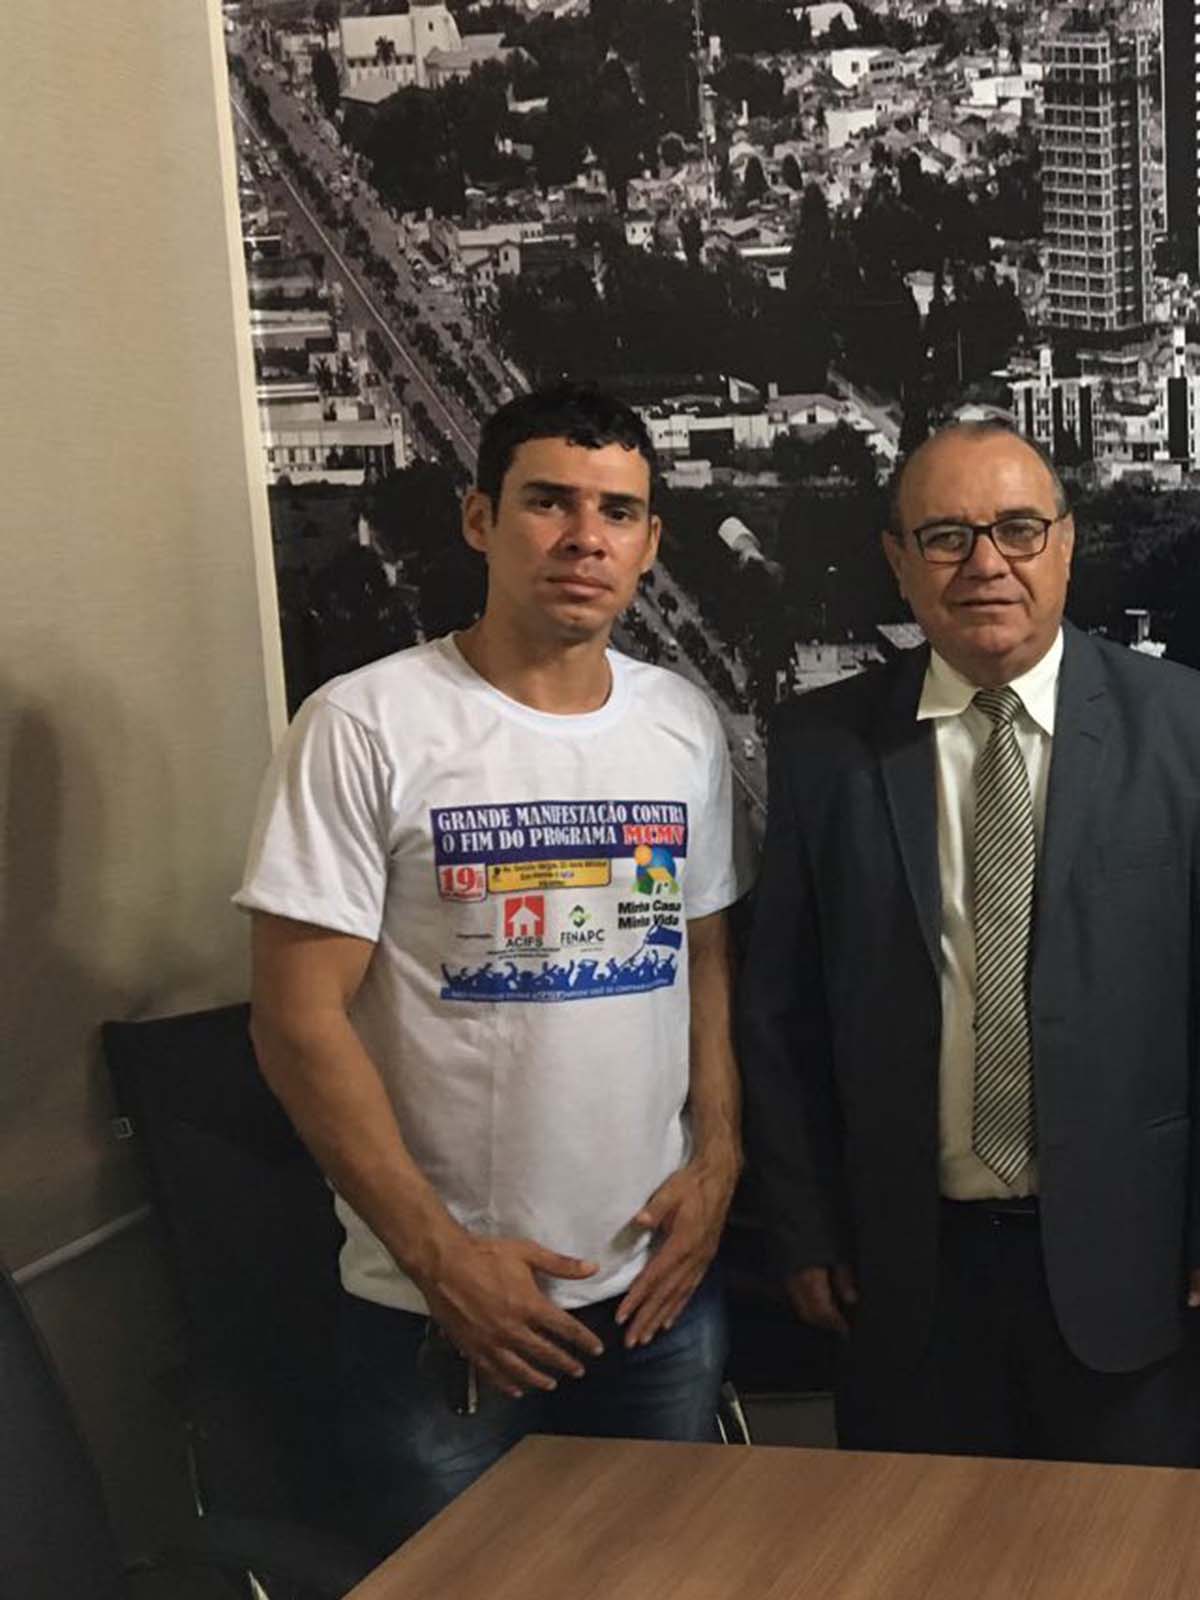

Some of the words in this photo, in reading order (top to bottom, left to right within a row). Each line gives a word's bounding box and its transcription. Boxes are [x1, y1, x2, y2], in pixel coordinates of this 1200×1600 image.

[437, 807, 512, 831] GRANDE
[632, 804, 685, 824] CONTRA
[441, 833, 455, 853] O
[460, 830, 494, 852] FIM
[498, 828, 525, 850] DO
[528, 825, 617, 847] PROGRAMA
[560, 929, 605, 945] FENAPC
